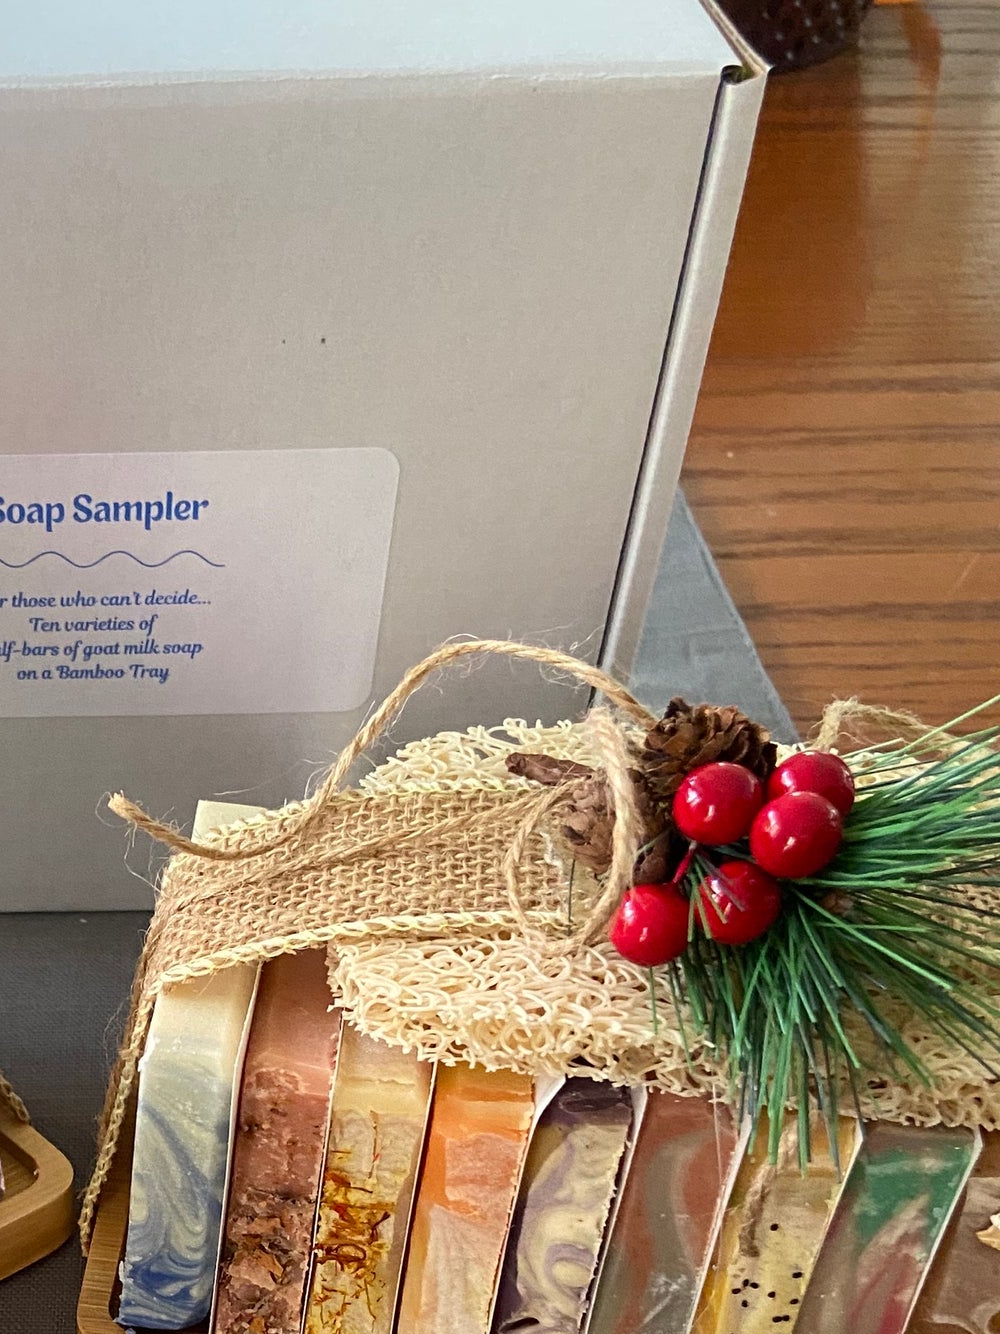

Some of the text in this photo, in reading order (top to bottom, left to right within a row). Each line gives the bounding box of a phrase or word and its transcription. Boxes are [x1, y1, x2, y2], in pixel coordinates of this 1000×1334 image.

[73, 491, 209, 531] Sampler
[12, 592, 58, 608] those
[60, 590, 97, 607] who
[100, 591, 142, 606] can't
[144, 589, 212, 605] decide...
[29, 614, 159, 636] Ten varieties of
[63, 640, 82, 661] of
[83, 641, 120, 661] goat
[123, 638, 160, 655] milk
[162, 643, 204, 659] soap
[17, 663, 170, 684] on a Bamboo Tray
